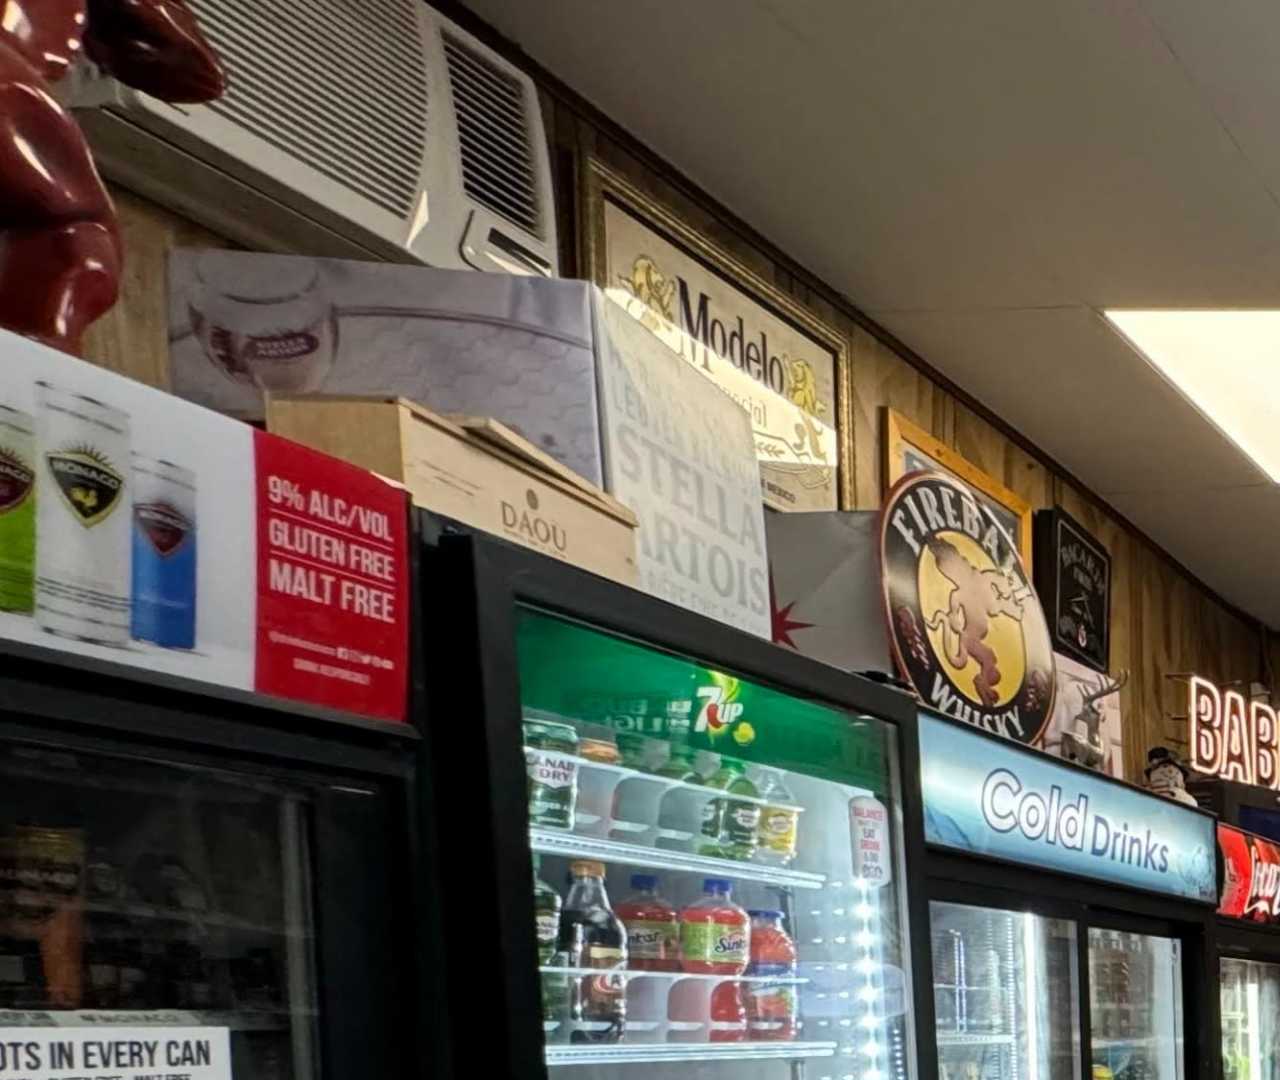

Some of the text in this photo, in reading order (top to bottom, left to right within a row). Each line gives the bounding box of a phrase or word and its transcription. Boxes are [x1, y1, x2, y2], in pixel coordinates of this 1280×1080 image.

[677, 276, 785, 395] Modelo
[268, 475, 393, 542] 9% ALC/VOL
[617, 424, 762, 556] STELLA
[269, 518, 393, 582] GLUTEN FREE
[502, 501, 566, 552] DAOU
[270, 561, 395, 624] MALT FREE
[982, 767, 1169, 874] Cold Drinks
[50, 1040, 212, 1070] IN EVERY CAN
